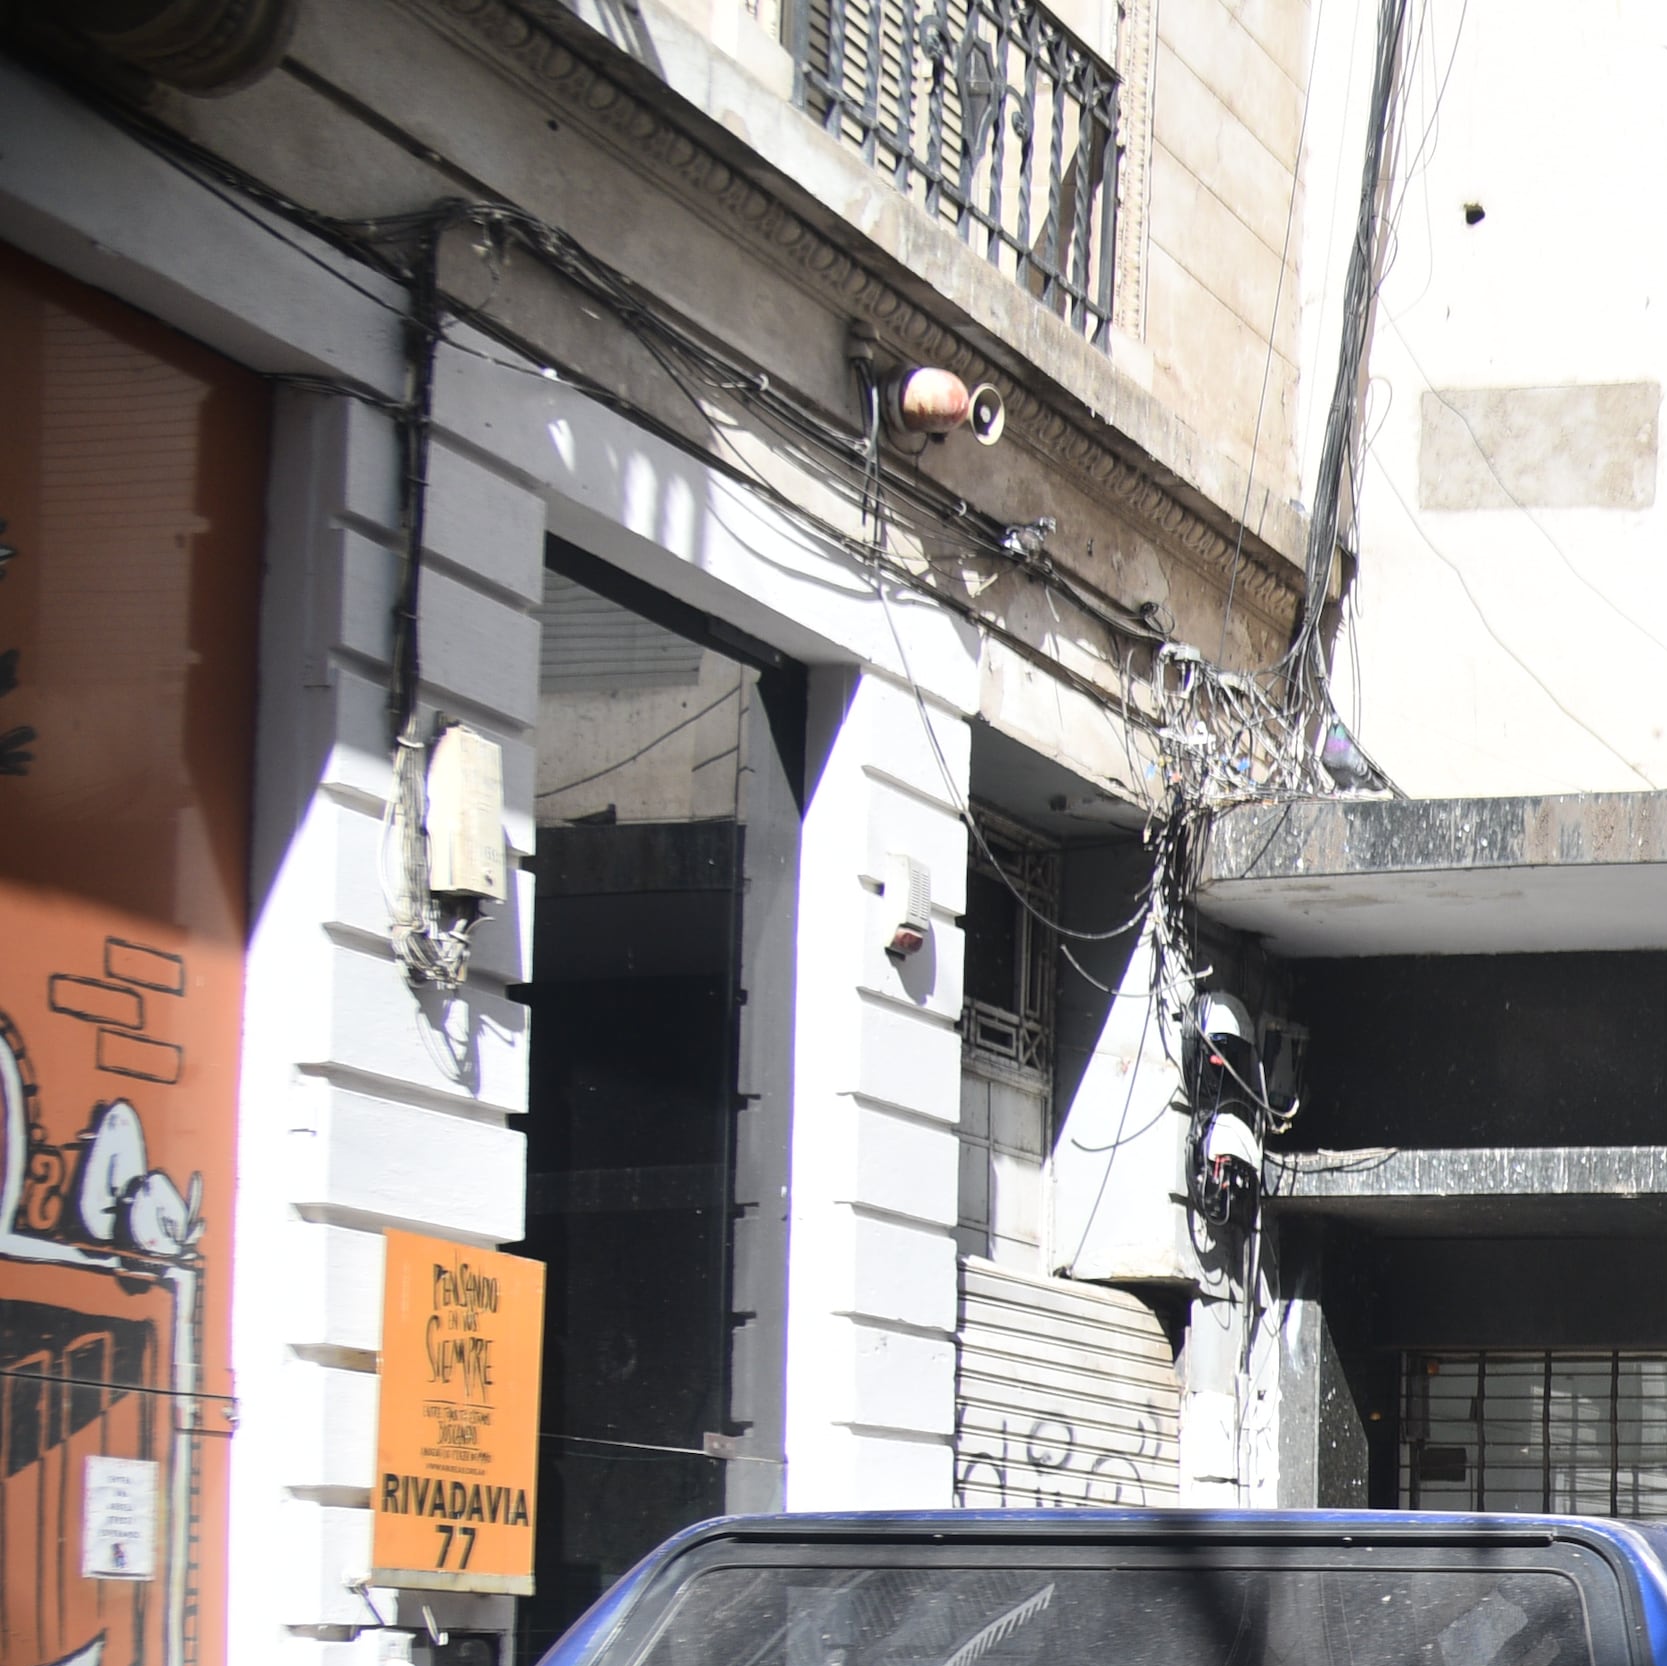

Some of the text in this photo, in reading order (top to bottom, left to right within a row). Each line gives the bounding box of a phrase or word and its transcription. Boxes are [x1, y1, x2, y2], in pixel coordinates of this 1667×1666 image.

[433, 1254, 499, 1313] PENSANDO
[426, 1314, 494, 1401] SIEMPRE
[381, 1473, 529, 1527] RIVADAVIA
[435, 1524, 477, 1569] 77
